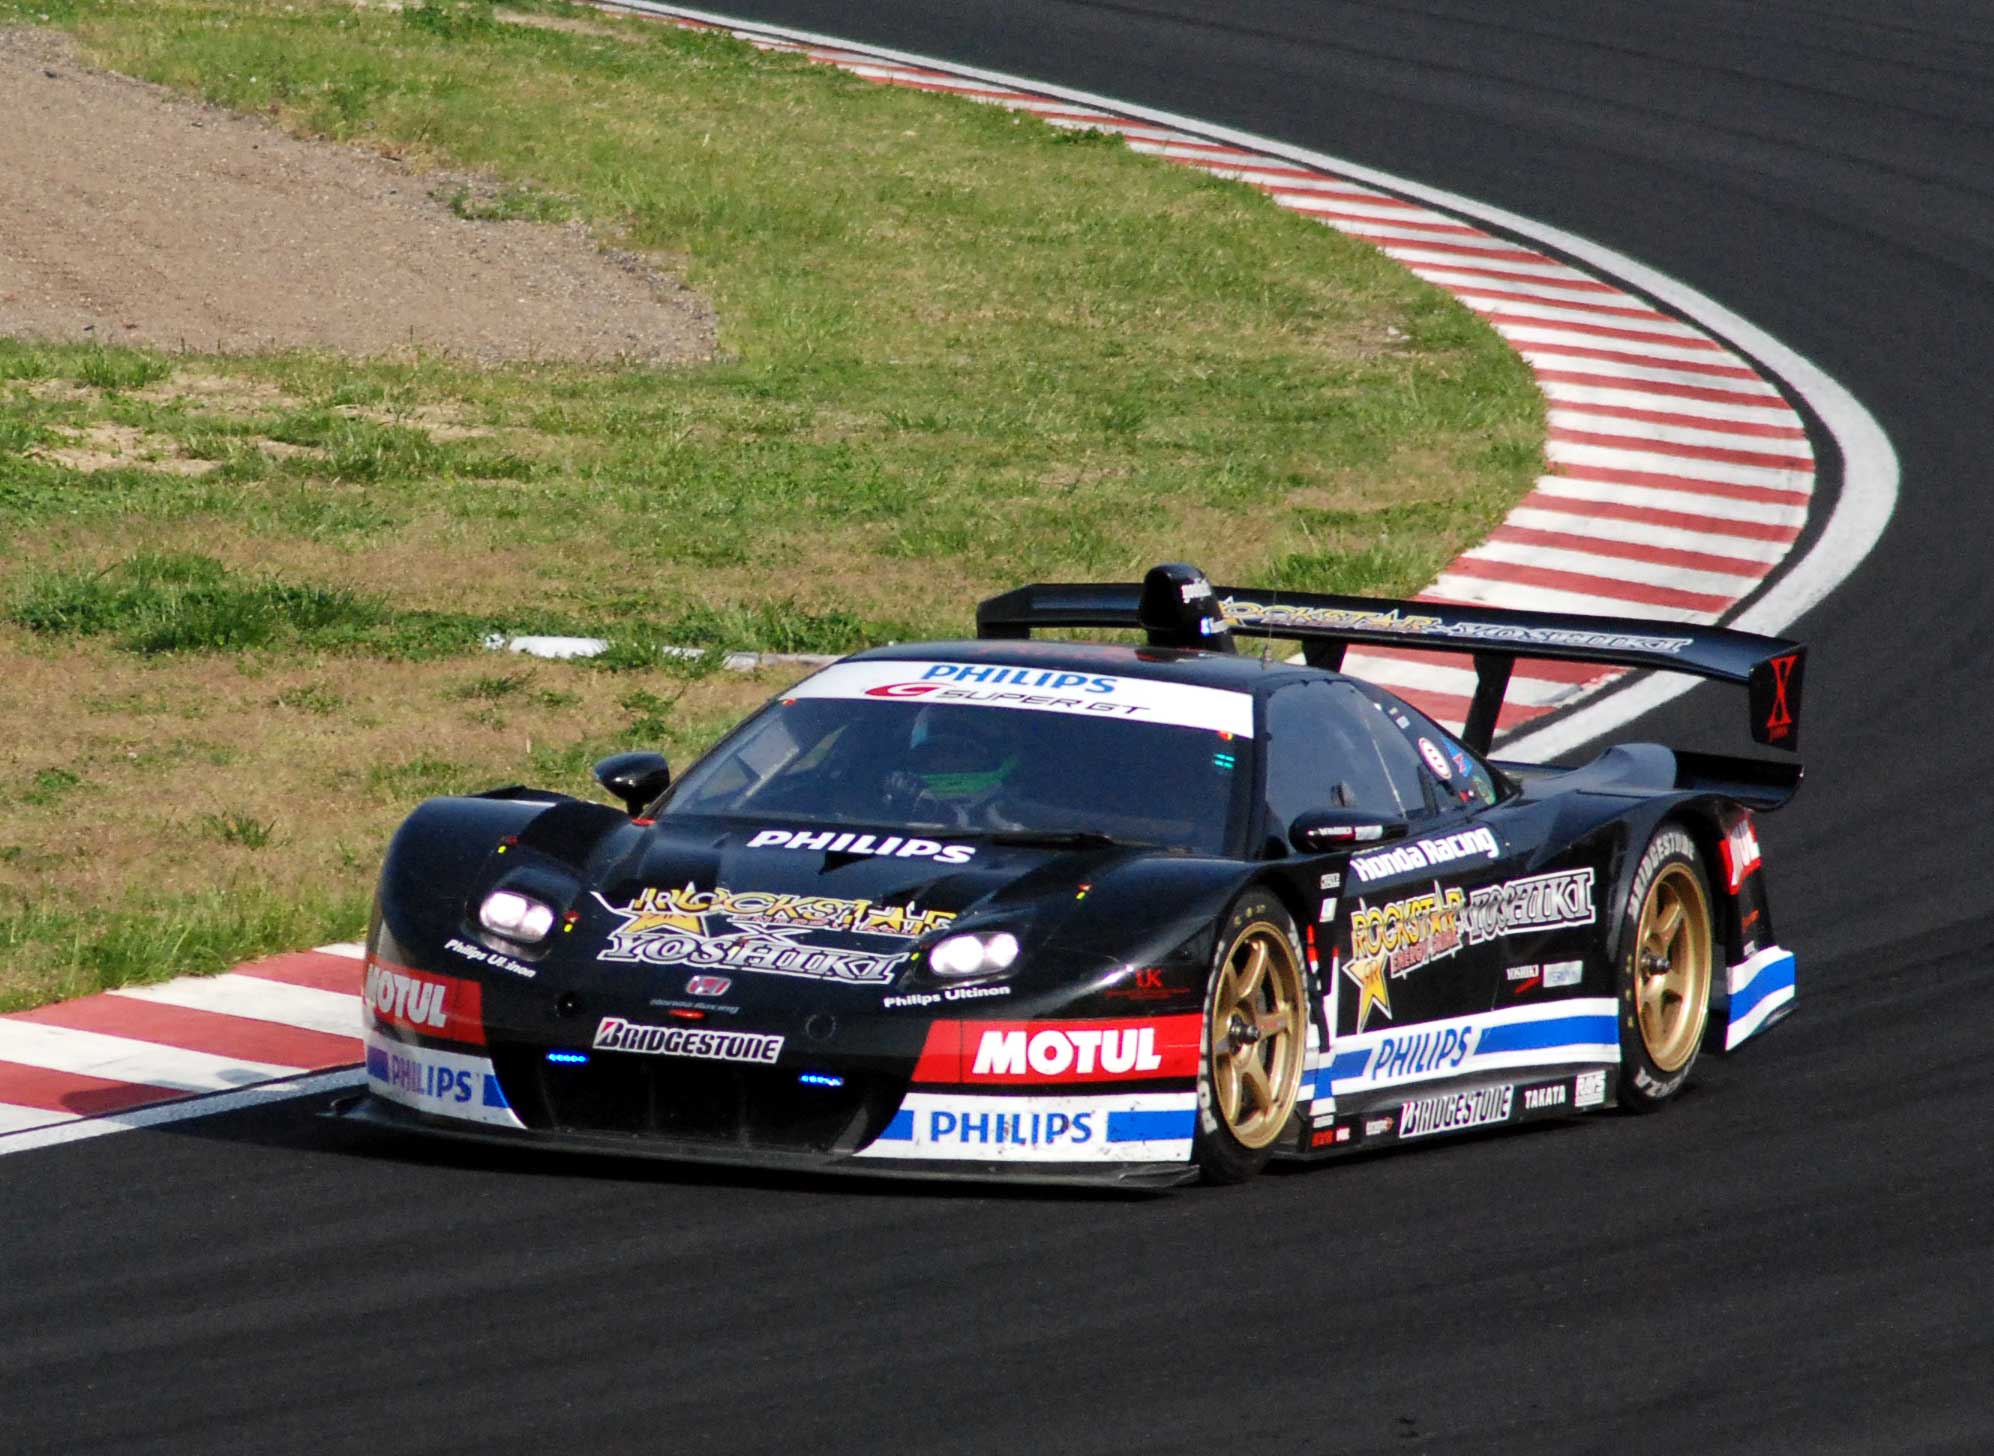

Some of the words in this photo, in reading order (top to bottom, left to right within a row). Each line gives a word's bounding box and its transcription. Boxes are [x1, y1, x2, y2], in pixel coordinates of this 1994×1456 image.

[1217, 597, 1442, 633] OCKSTAR
[921, 665, 1118, 694] PHILIPS
[936, 689, 1082, 708] SUPER
[1091, 701, 1151, 715] GT
[747, 830, 976, 864] PHILIPS
[1350, 848, 1428, 882] Honda
[1417, 827, 1499, 864] Racing
[1350, 881, 1466, 960] ROCKSTAR
[1470, 867, 1595, 945] YOSHIKI
[444, 938, 488, 960] Philips
[598, 931, 910, 984] YOSHIKI
[365, 962, 448, 1029] MOTUL
[883, 993, 942, 1008] Philips
[944, 985, 1011, 1001] Ultinon
[596, 1019, 782, 1062] BRIDGESTONE
[971, 1027, 1162, 1075] MOTUL
[1371, 1025, 1472, 1081] PHILIPS
[390, 1054, 472, 1103] PHILIPS
[1524, 1085, 1566, 1109] TAKATA
[929, 1110, 1093, 1144] PHILIPS
[1400, 1084, 1513, 1137] BRIDGESTONE
